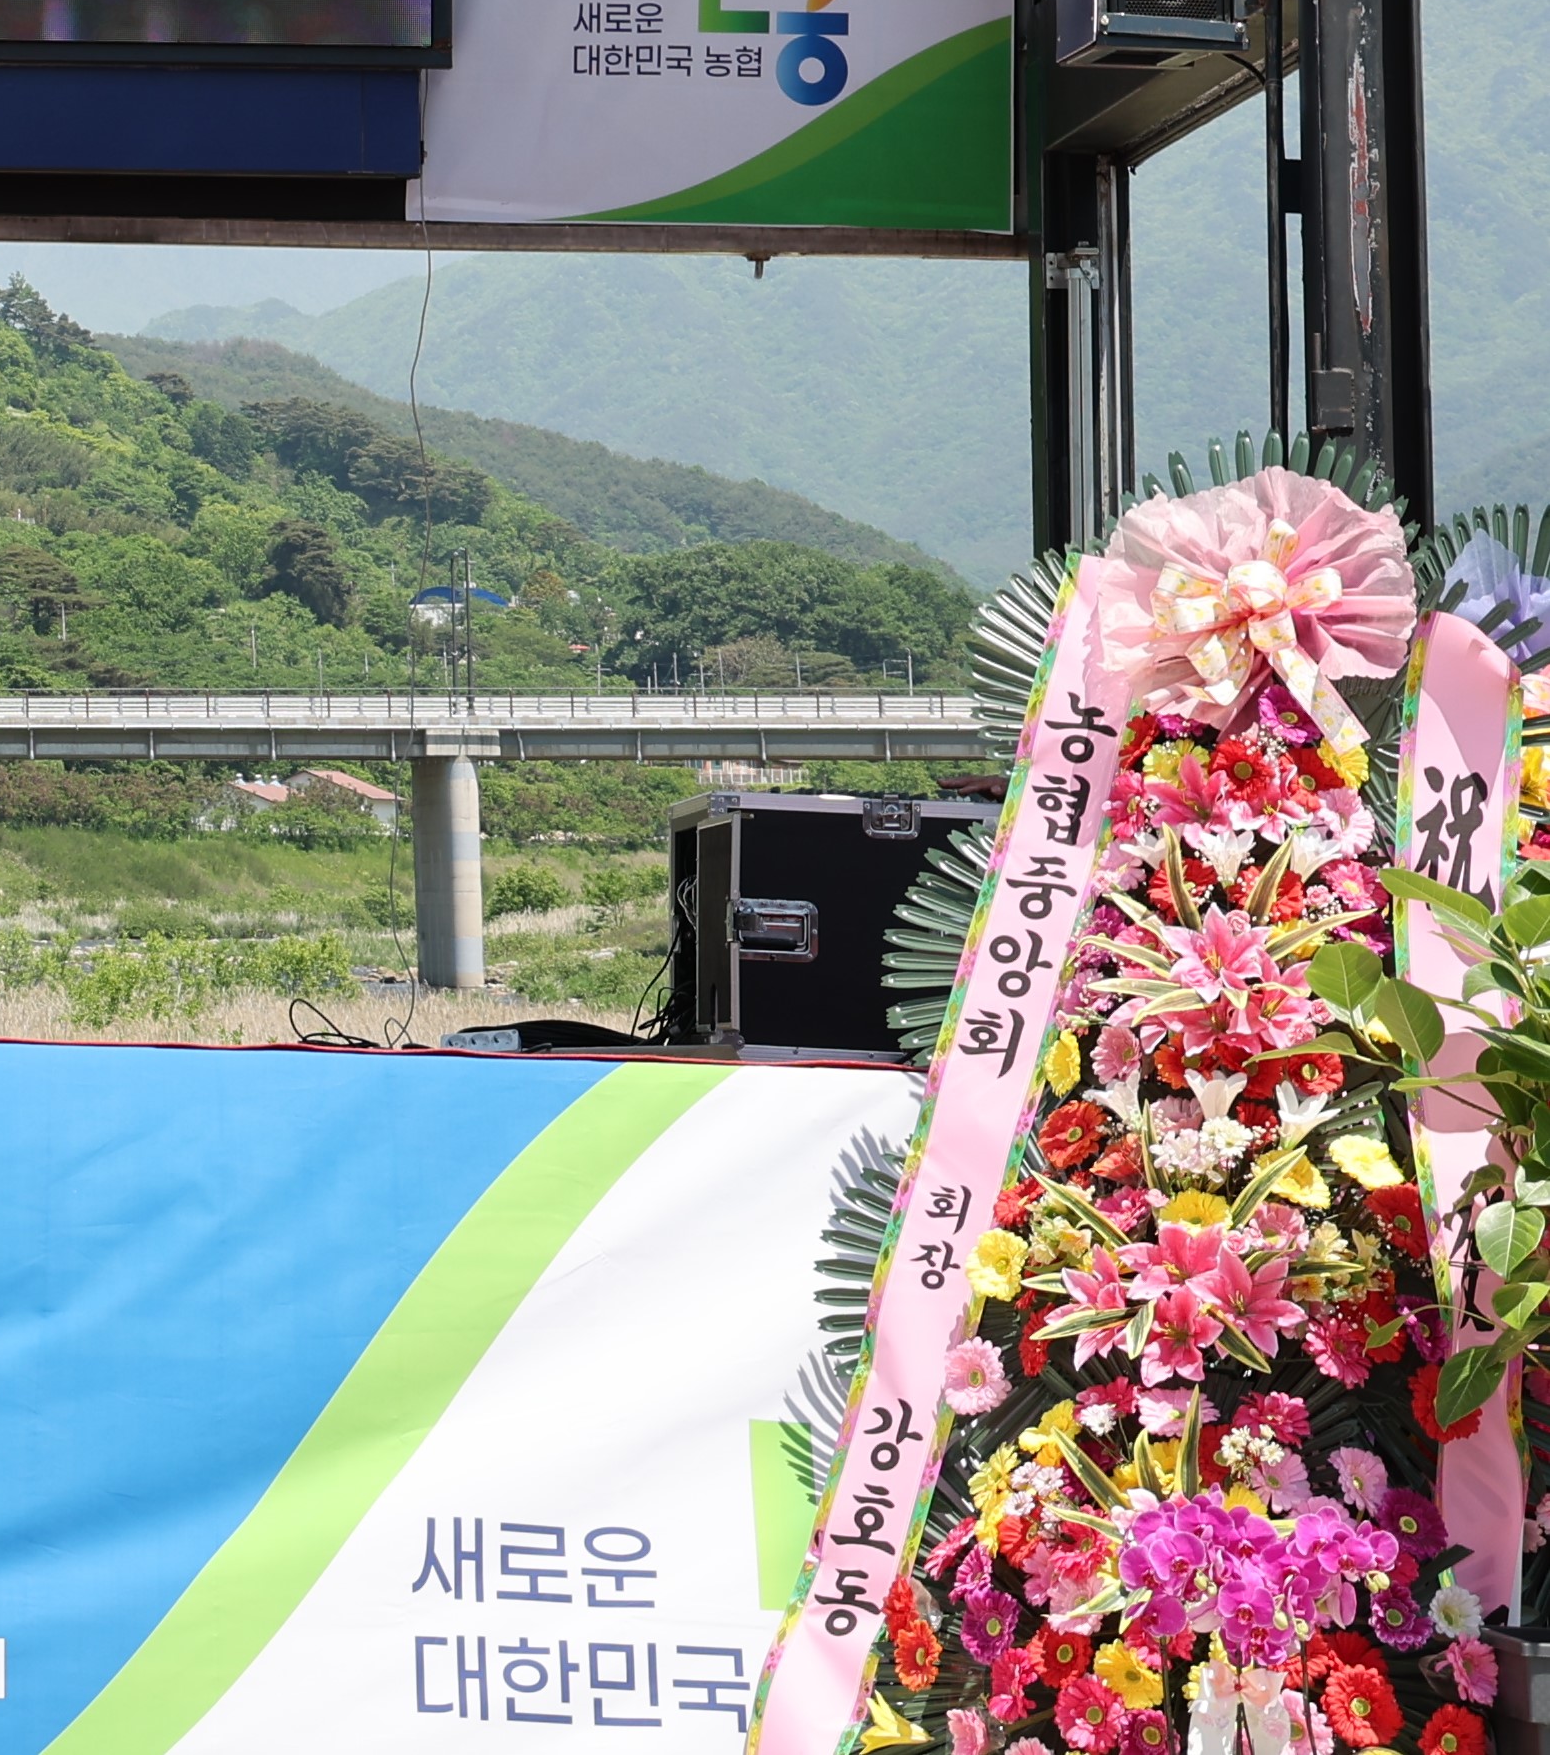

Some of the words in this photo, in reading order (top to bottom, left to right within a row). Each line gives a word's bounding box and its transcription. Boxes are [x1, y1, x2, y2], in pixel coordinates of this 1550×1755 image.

[572, 1, 664, 35] 새로운
[572, 44, 694, 77] 대한민국
[703, 45, 763, 78] 농협
[958, 692, 1118, 1080] 농협중앙회
[908, 1184, 974, 1291] 회장
[412, 1517, 657, 1608] 새로운
[813, 1397, 923, 1639] 강호동
[415, 1635, 751, 1733] 대한민국
